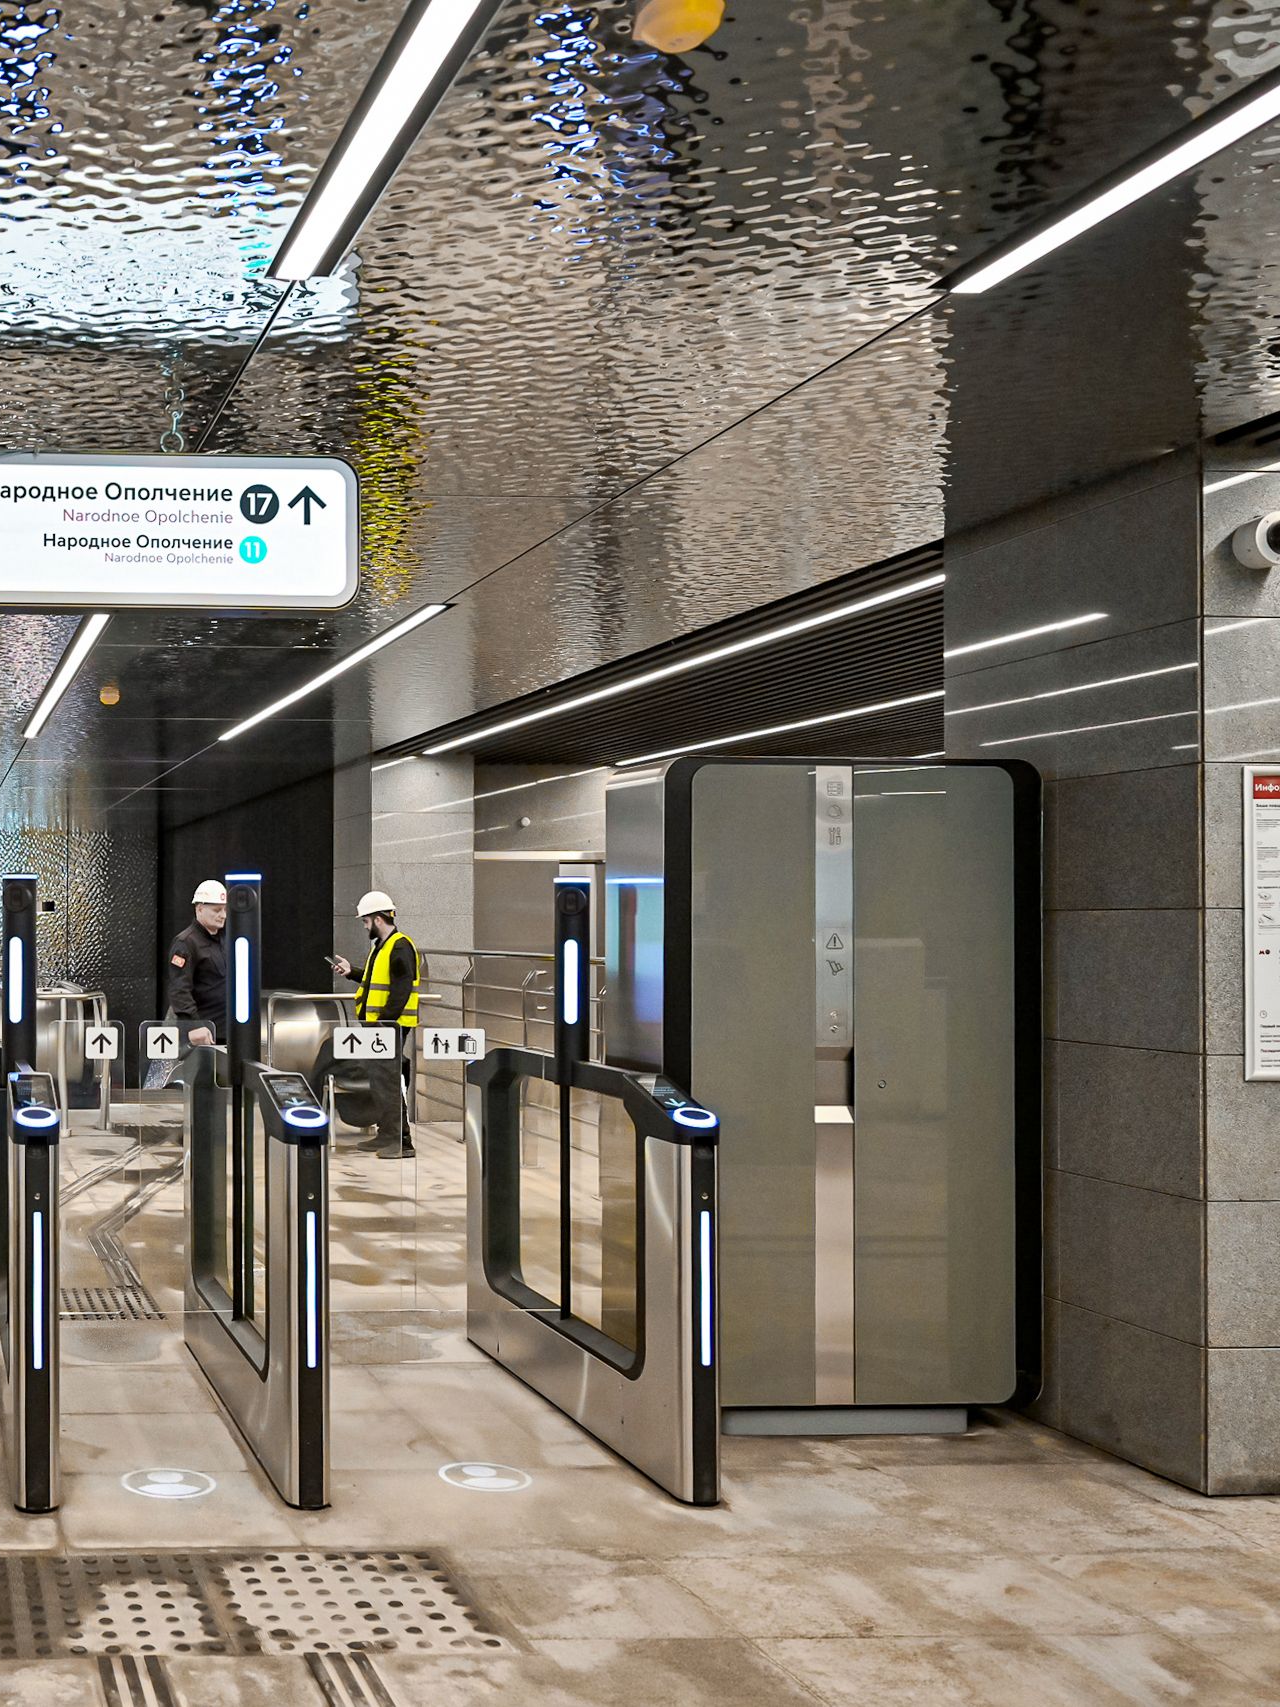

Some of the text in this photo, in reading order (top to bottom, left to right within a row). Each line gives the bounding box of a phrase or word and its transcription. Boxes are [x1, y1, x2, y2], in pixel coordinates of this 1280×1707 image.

[104, 482, 233, 502] Ополчение
[245, 492, 272, 516] 17
[63, 508, 234, 526] Narodnoe Opolchenie
[43, 533, 261, 558] Народное Ополчение 11
[104, 552, 234, 566] Narodnoe Opolchenie
[1255, 783, 1280, 793] Инфо
